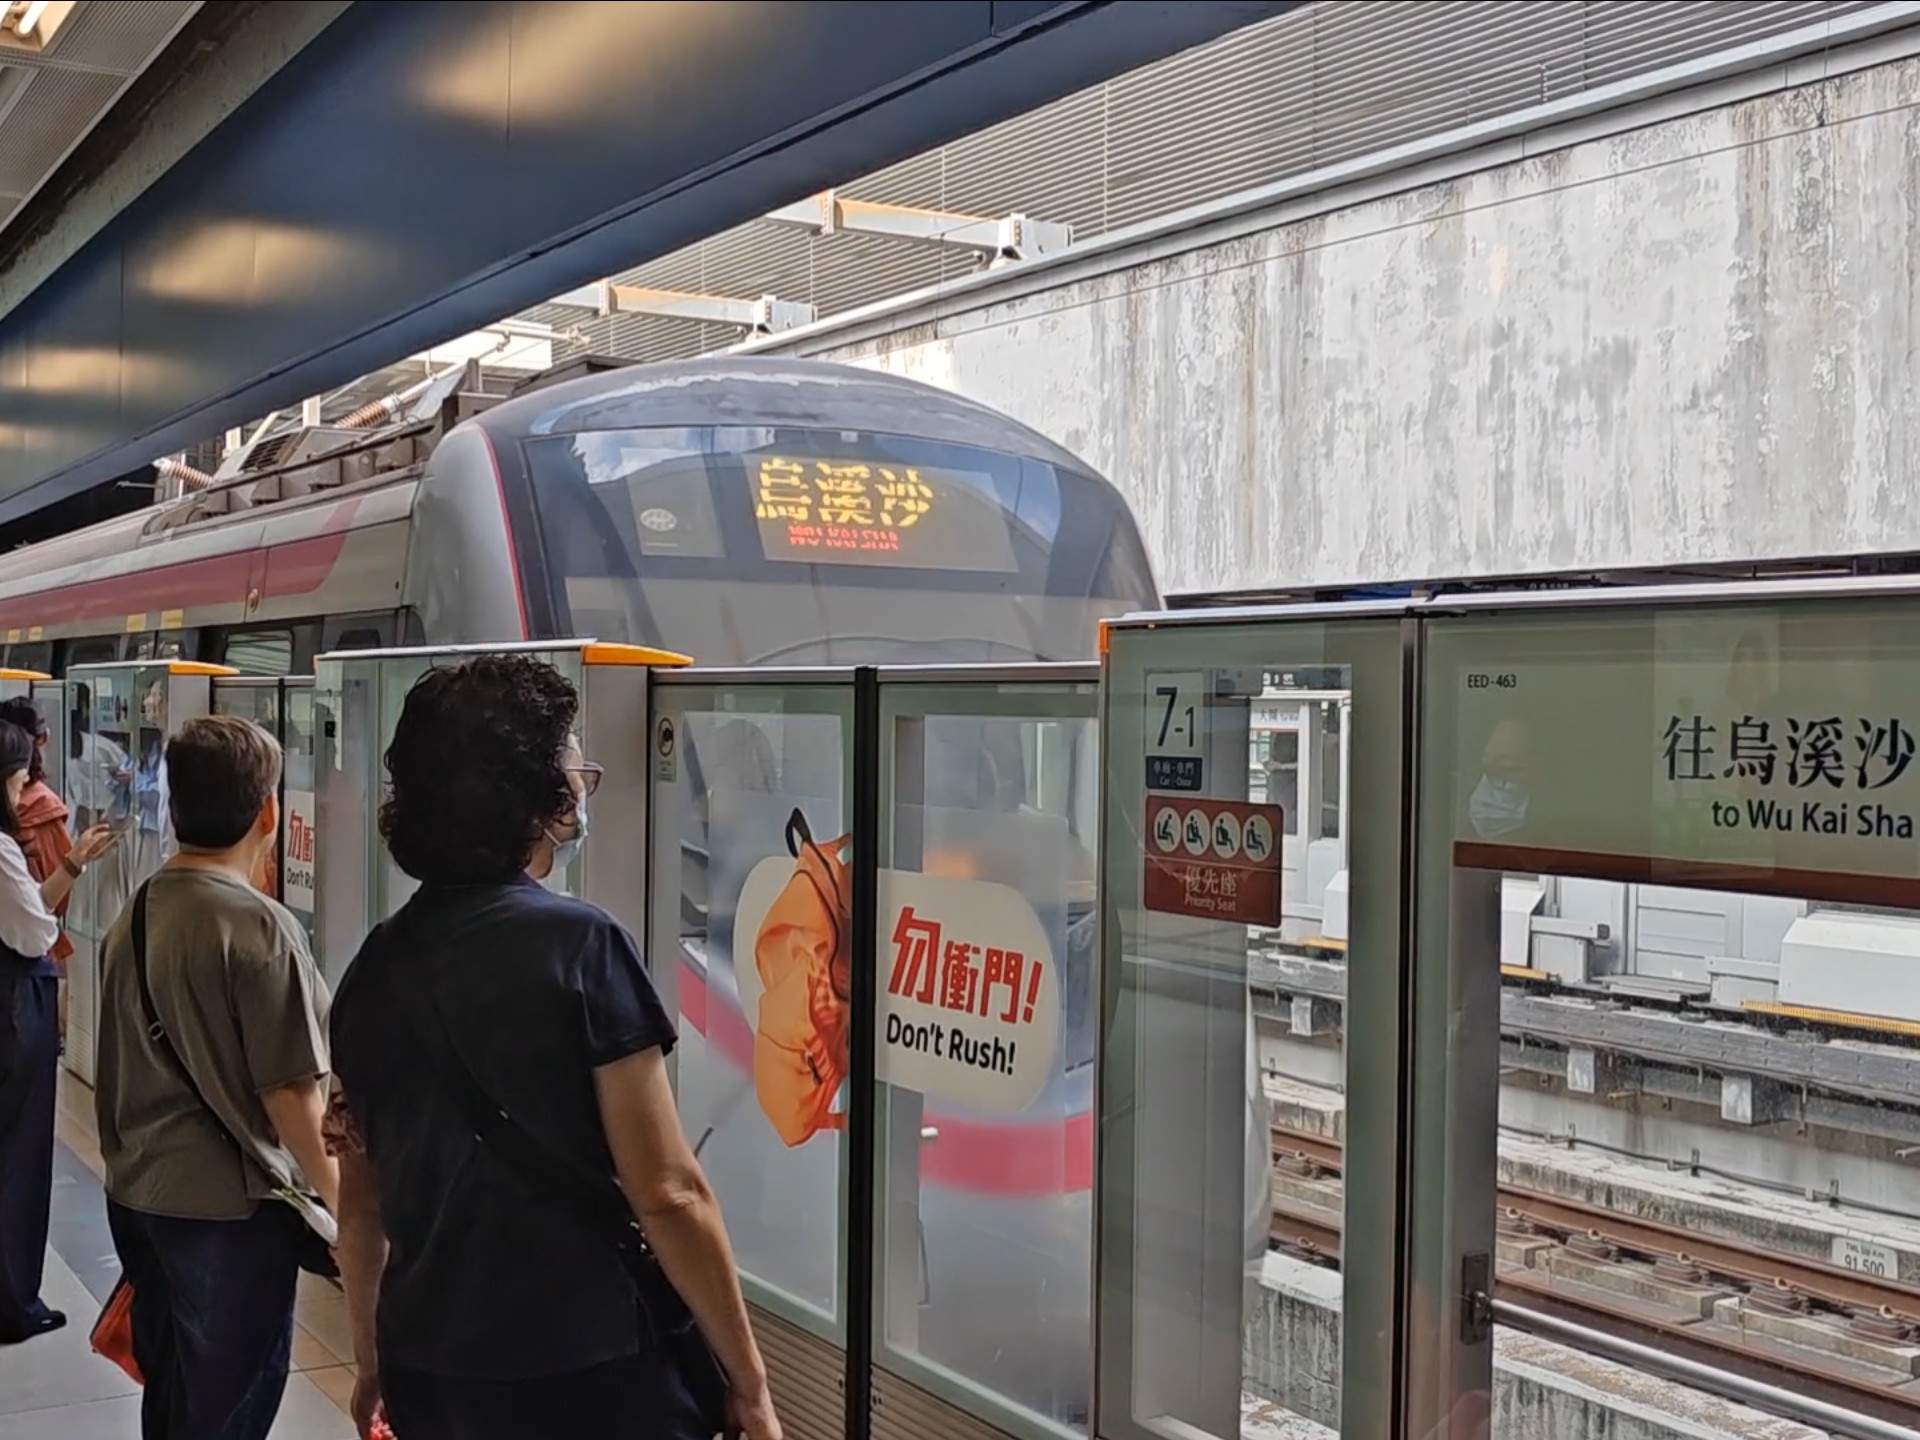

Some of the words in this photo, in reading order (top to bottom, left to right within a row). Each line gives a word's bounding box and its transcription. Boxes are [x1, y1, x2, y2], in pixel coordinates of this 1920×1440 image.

[756, 458, 933, 527] 烏溪沙
[1156, 686, 1194, 748] 7-1
[1662, 715, 1916, 790] 往烏溪沙
[1711, 801, 1740, 828] to
[1747, 799, 1793, 832] Wu
[1802, 802, 1847, 834] Kai
[1856, 804, 1913, 839] Sha
[1216, 897, 1236, 912] Seat
[888, 906, 1043, 1024] 勿衝門!
[886, 1013, 944, 1056] Don't
[948, 1028, 1015, 1076] Rush!
